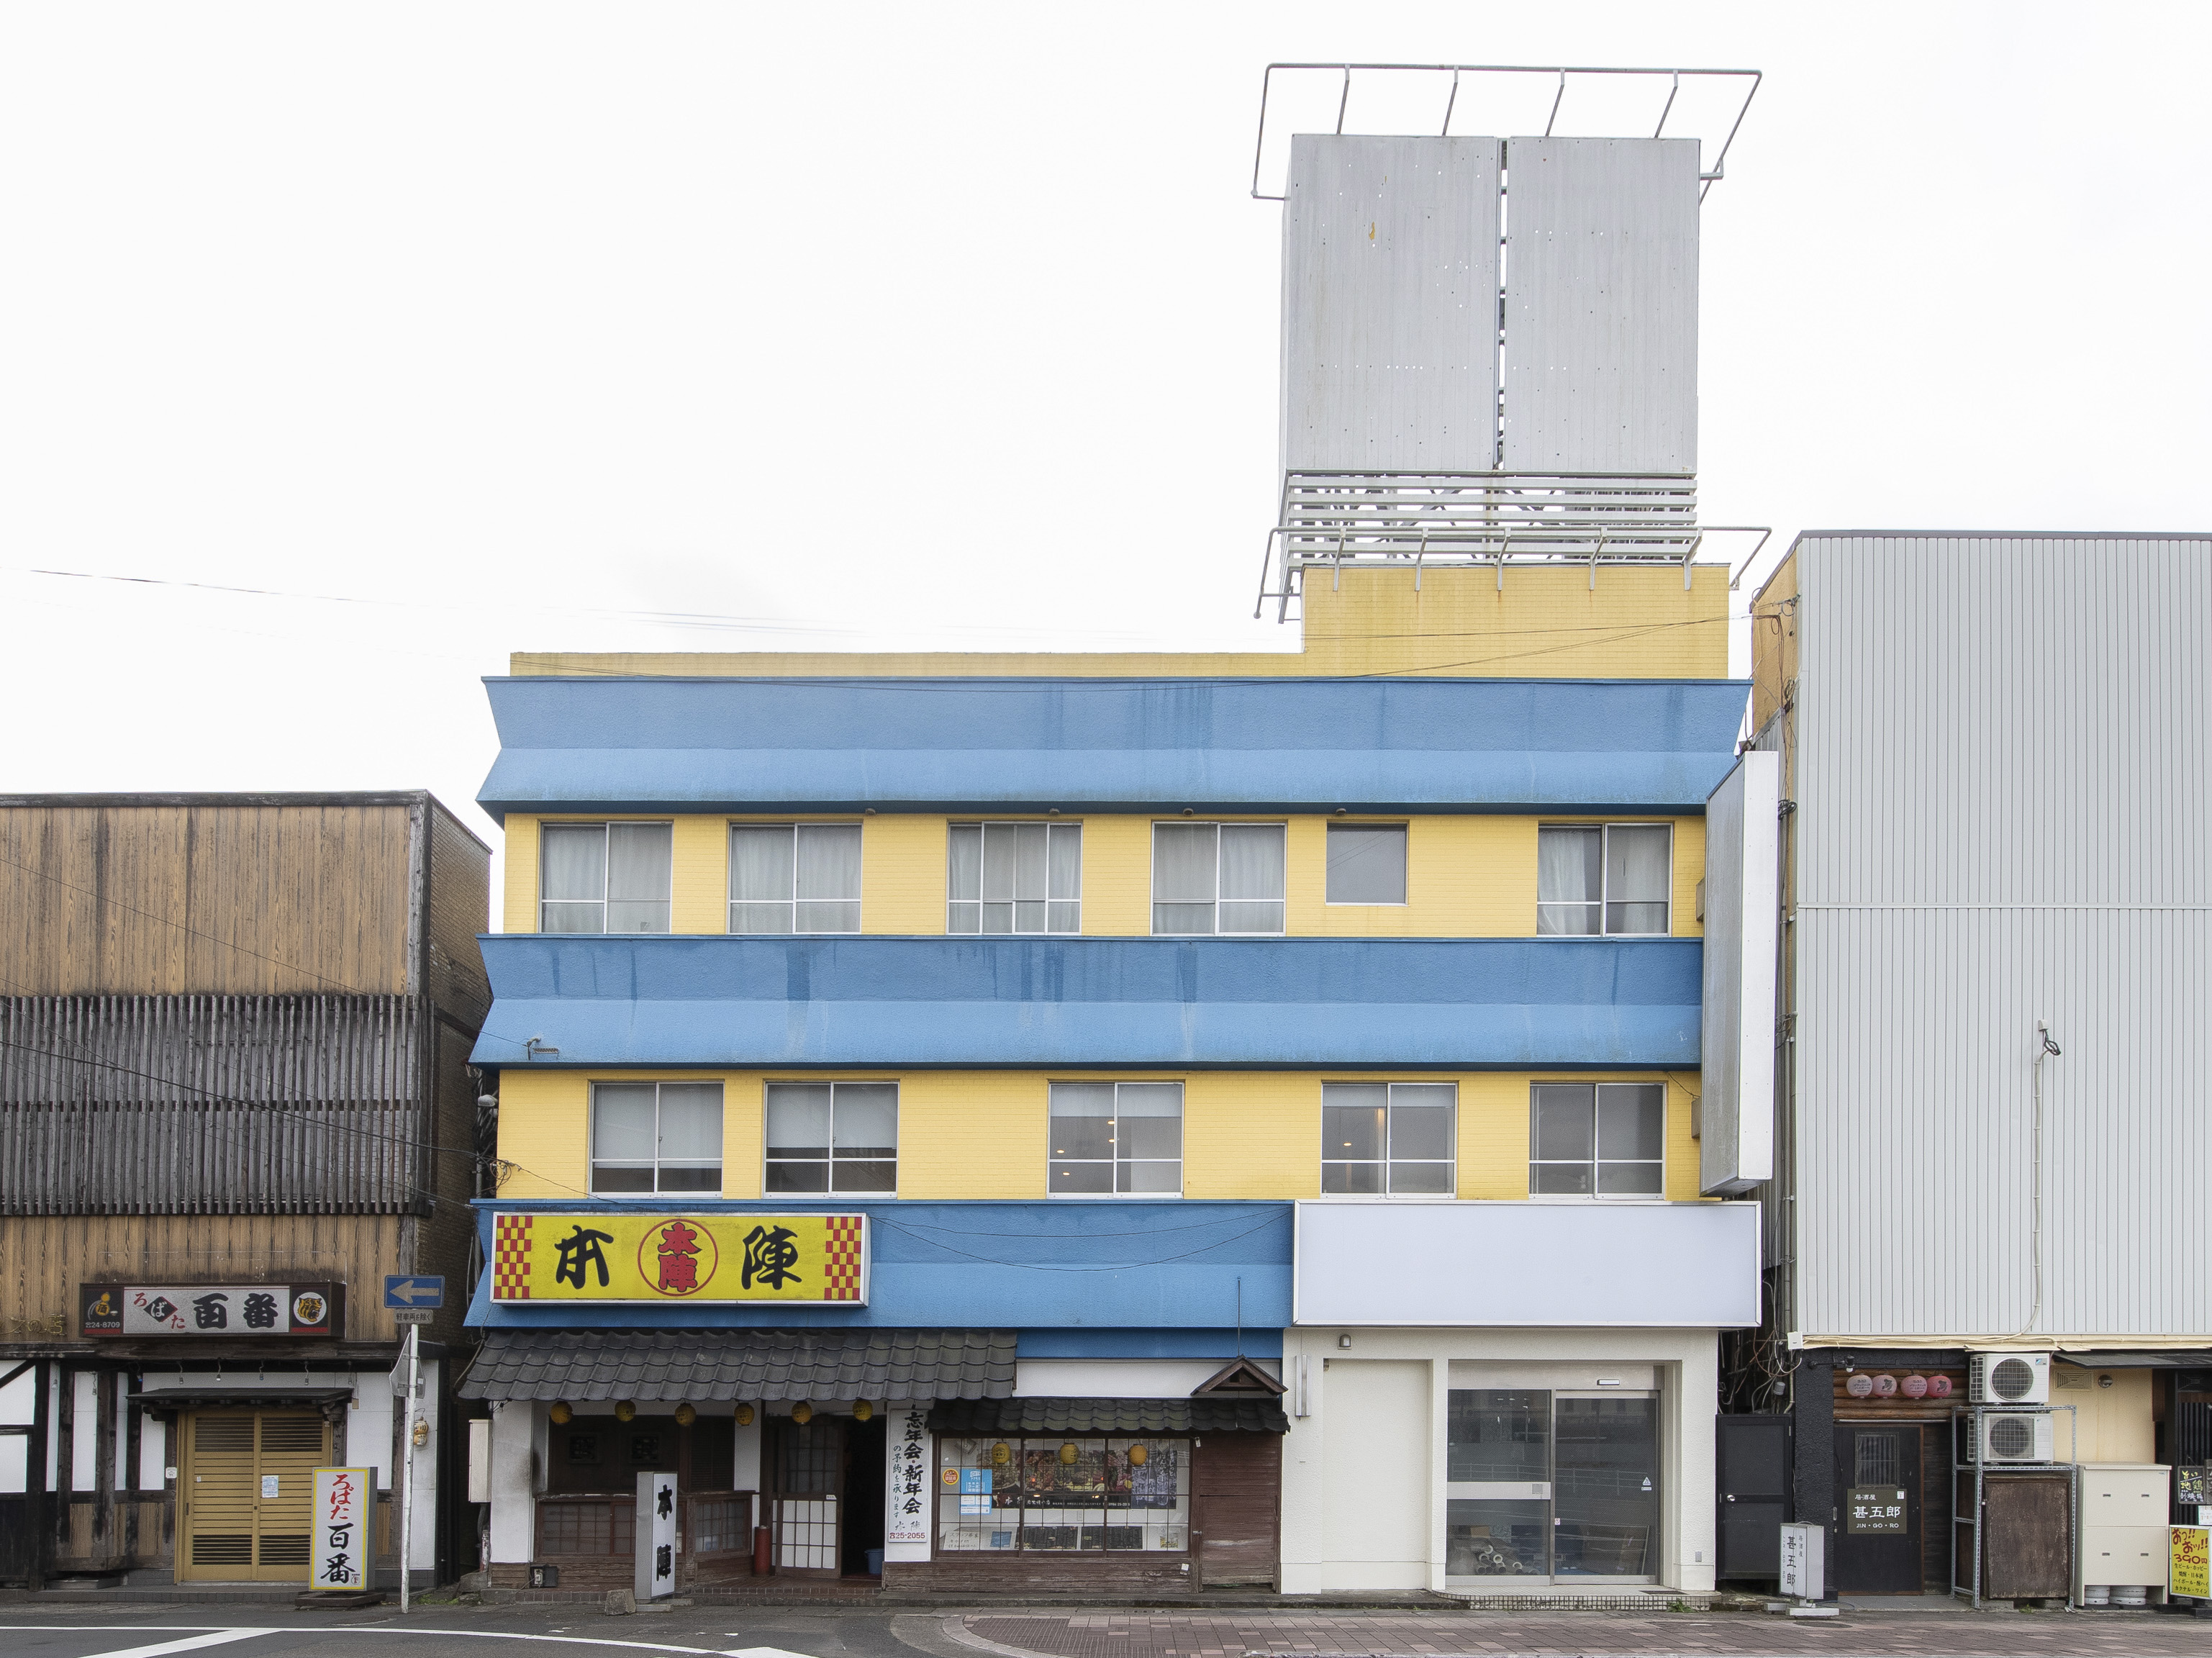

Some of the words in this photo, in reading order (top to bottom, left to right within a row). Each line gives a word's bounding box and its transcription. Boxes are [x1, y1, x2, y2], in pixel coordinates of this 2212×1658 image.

[658, 1222, 702, 1292] 本陣
[134, 1292, 186, 1330] ろばた
[192, 1292, 279, 1329] 百番
[396, 1313, 430, 1321] 軽車両を除く
[892, 1445, 902, 1518] の予約を承ります
[902, 1412, 924, 1514] 忘年会・新年会
[330, 1474, 354, 1520] ろばた
[1852, 1505, 1901, 1518] 甚五郎
[320, 1523, 356, 1584] 百番
[656, 1484, 673, 1582] 本陣
[1787, 1536, 1796, 1586] 甚五郎
[2174, 1554, 2208, 1564] 390円
